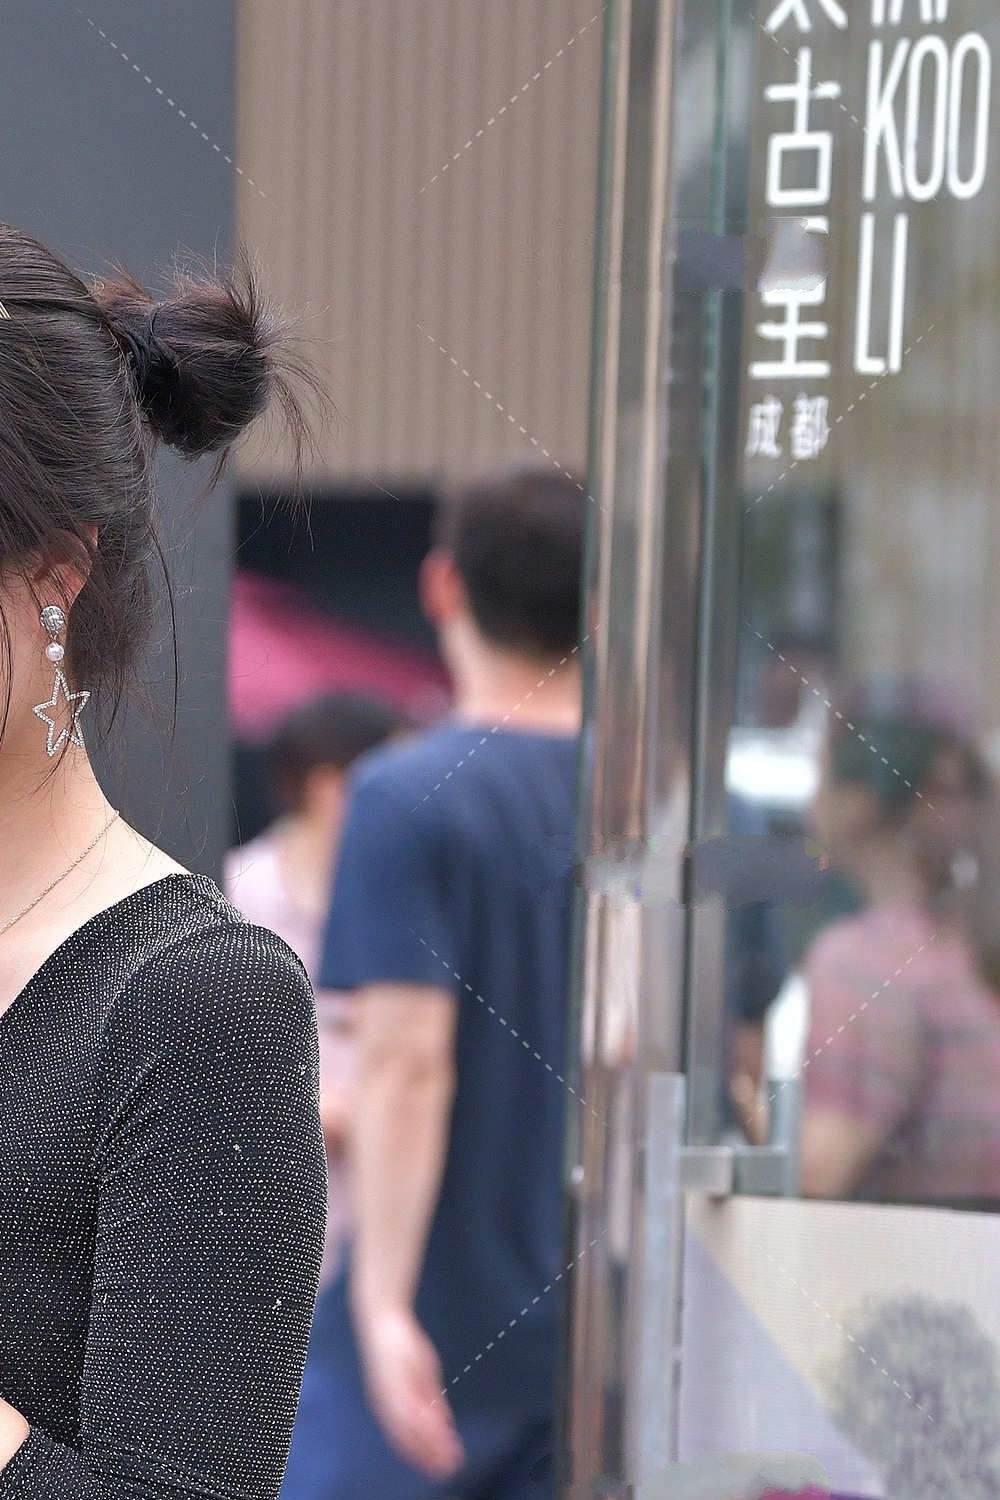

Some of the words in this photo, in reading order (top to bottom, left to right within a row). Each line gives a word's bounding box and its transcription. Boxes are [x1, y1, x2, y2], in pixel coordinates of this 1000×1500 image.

[861, 32, 991, 201] KOO
[854, 212, 909, 375] LI
[745, 394, 830, 460] 成都
